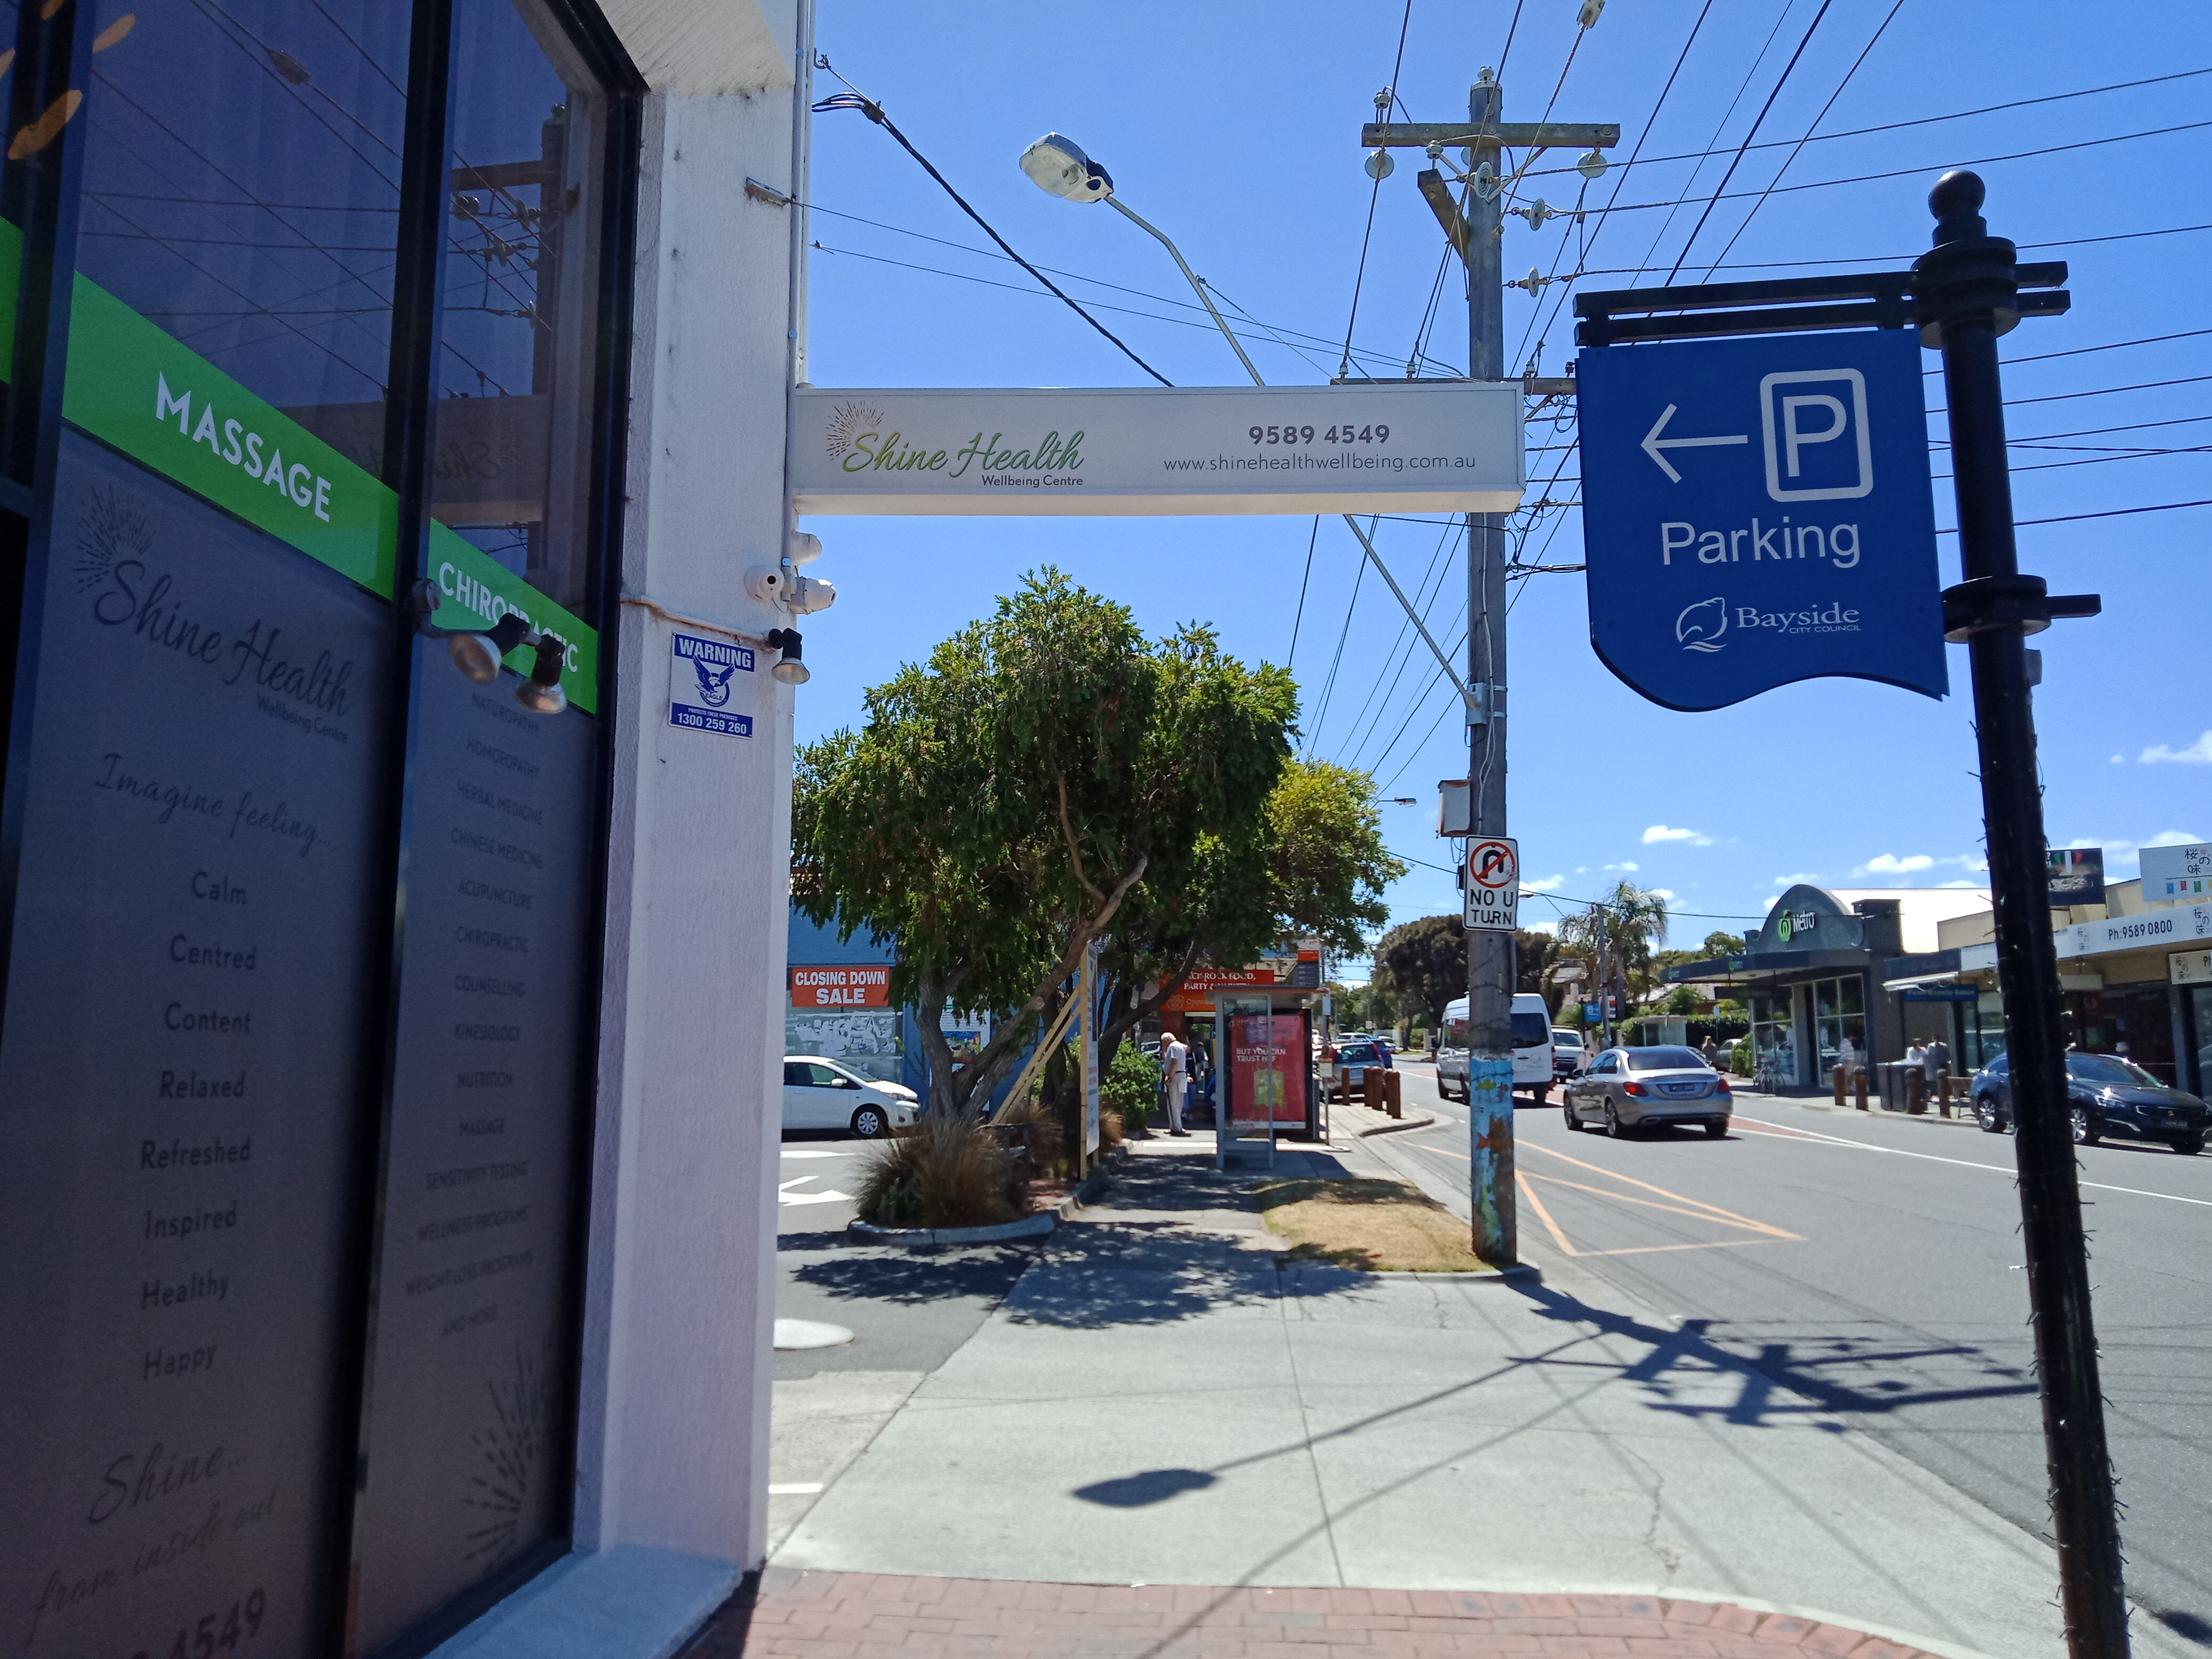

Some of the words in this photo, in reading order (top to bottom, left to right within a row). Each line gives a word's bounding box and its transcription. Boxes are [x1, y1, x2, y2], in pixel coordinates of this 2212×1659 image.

[156, 371, 331, 522] MASSAGE
[1249, 425, 1314, 445] 9589
[1324, 425, 1390, 445] 4549
[1782, 395, 1847, 477] P
[842, 431, 949, 472] Shine
[949, 431, 1085, 478] Health
[1163, 453, 1476, 472] www.shinehealthwellbeing.com.au
[982, 475, 1040, 488] Wellbeing
[1043, 475, 1083, 486] Centre
[1662, 516, 1860, 568] Parking
[439, 562, 578, 673] CHIROIC
[1736, 602, 1859, 633] Bayside
[94, 559, 222, 664] Shine
[222, 619, 353, 716] Health
[678, 638, 751, 668] WARNING
[257, 693, 312, 733] Wellbeing
[314, 717, 348, 744] Centre
[678, 713, 702, 726] 1300
[706, 718, 725, 731] 259
[728, 722, 747, 734] 260
[95, 752, 224, 824] Imagine
[191, 870, 246, 904] Calm
[1470, 889, 1495, 906] NO
[1504, 891, 1513, 907] U
[1471, 909, 1512, 925] TURN
[1794, 910, 1815, 933] Metro
[2148, 920, 2172, 935] 0800
[170, 934, 256, 970] Centred
[795, 971, 847, 985] CLOSING
[850, 971, 885, 985] DOWN
[816, 988, 865, 1004] SALE
[165, 1002, 251, 1033] Content
[160, 1070, 245, 1099] Relaxed
[140, 1135, 251, 1169] Refreshed
[145, 1200, 237, 1240] Inspired
[142, 1269, 229, 1310] Healthy
[143, 1345, 217, 1381] Happy
